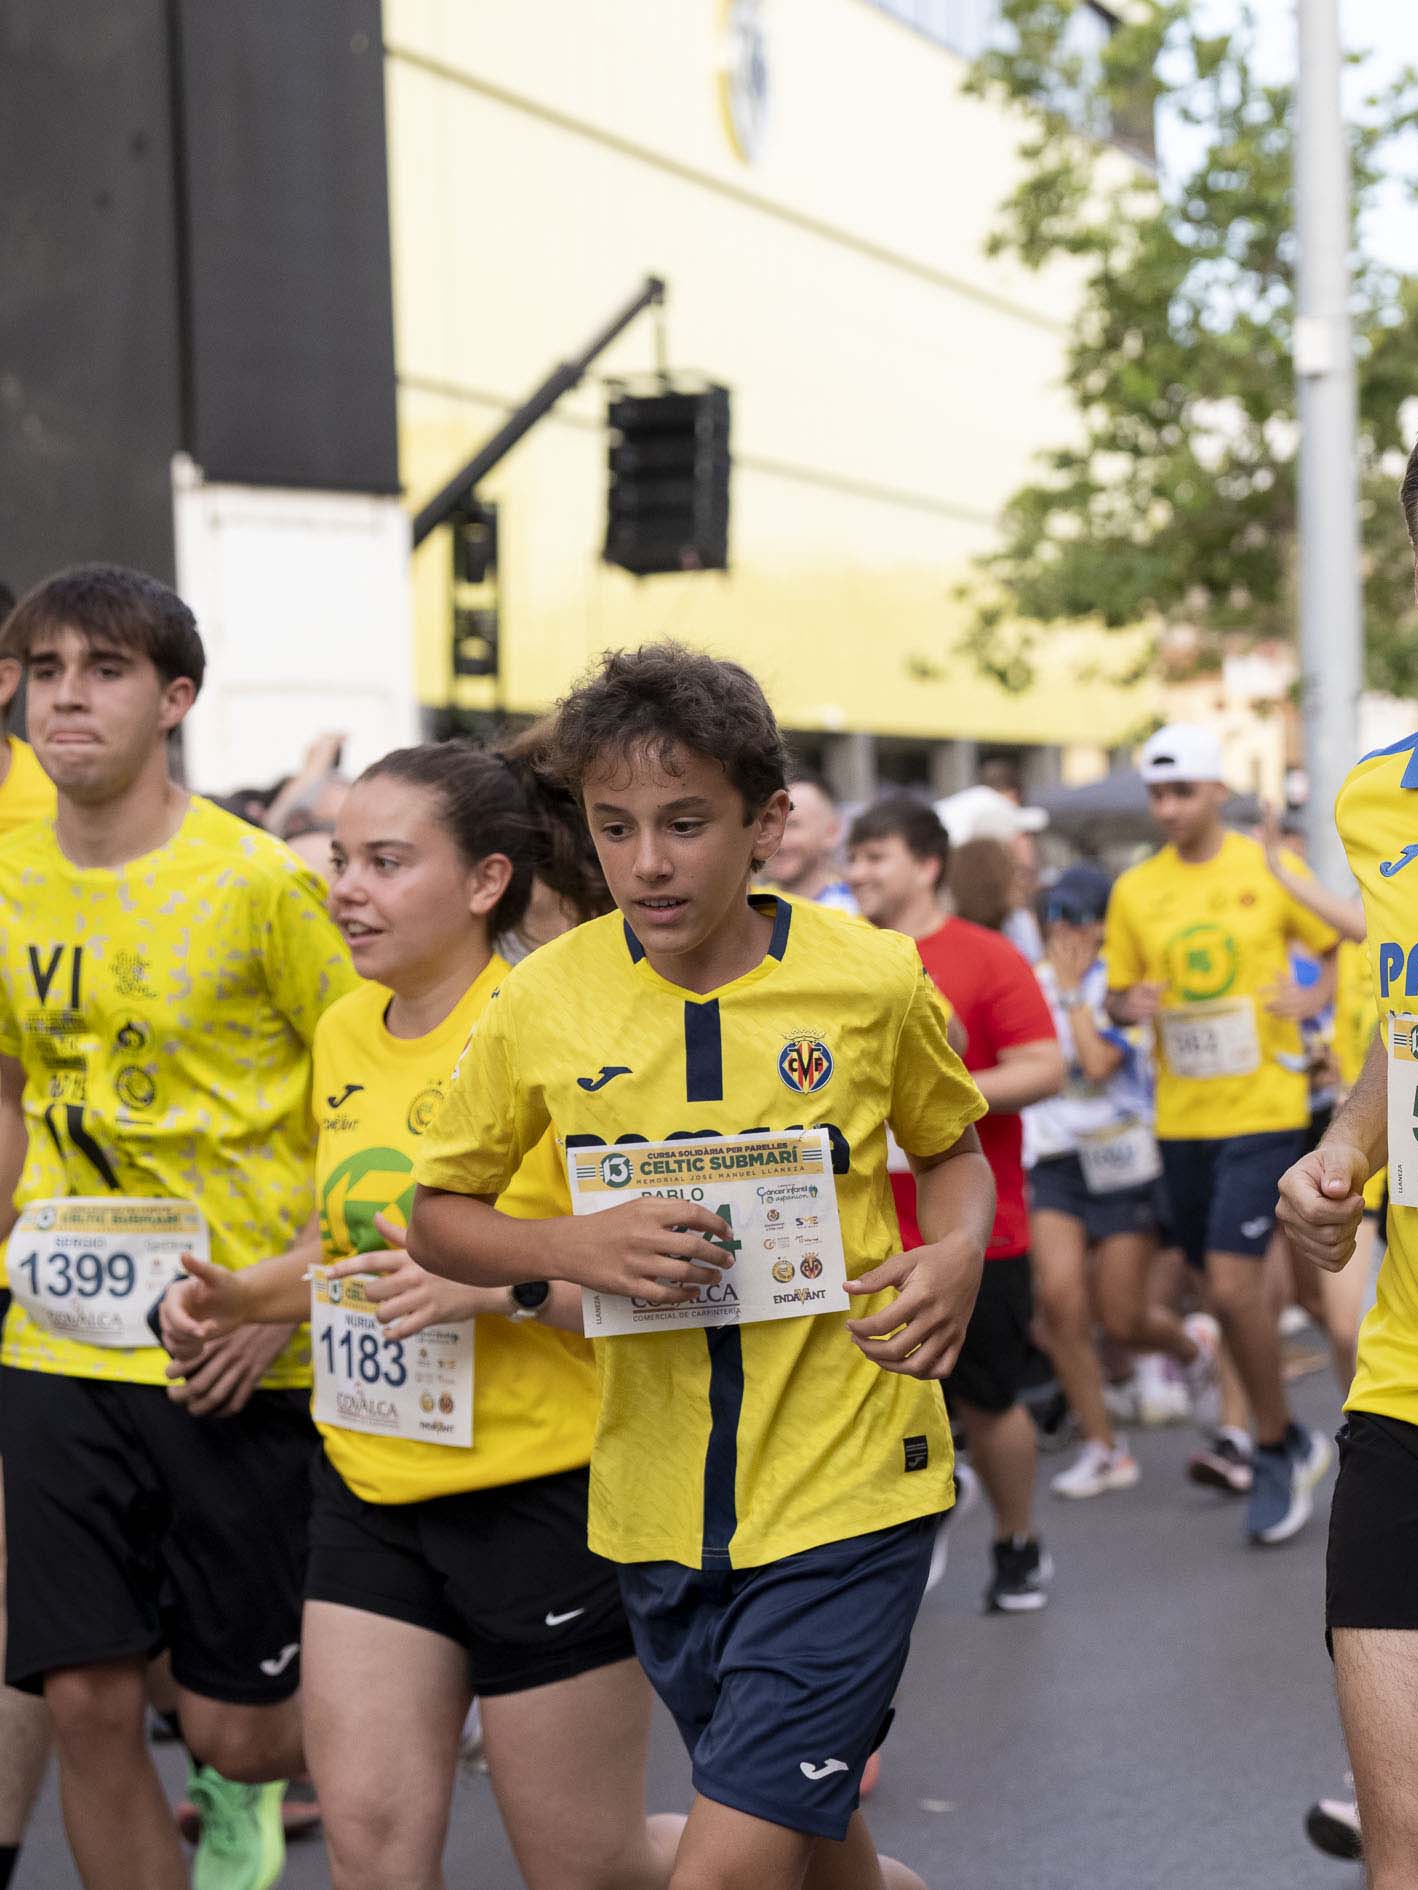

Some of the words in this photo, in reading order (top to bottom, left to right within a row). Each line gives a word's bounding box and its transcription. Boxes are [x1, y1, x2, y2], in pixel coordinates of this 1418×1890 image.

[647, 1151, 676, 1160] CURSA
[678, 1147, 724, 1158] SOLIDÀRIA
[726, 1146, 743, 1155] PER
[745, 1142, 788, 1153] PARELLES
[639, 1158, 705, 1176] CELTIC
[710, 1147, 798, 1171] SUBMARÍ
[636, 1175, 685, 1185] MEMORIAL
[718, 1169, 756, 1179] MANUEL
[762, 1165, 805, 1175] LLANEZA
[19, 1250, 136, 1298] 1399
[773, 1287, 826, 1305] ENDAVANT
[632, 1312, 677, 1322] COMERCIAL
[679, 1311, 689, 1319] DE
[321, 1325, 407, 1387] 1183
